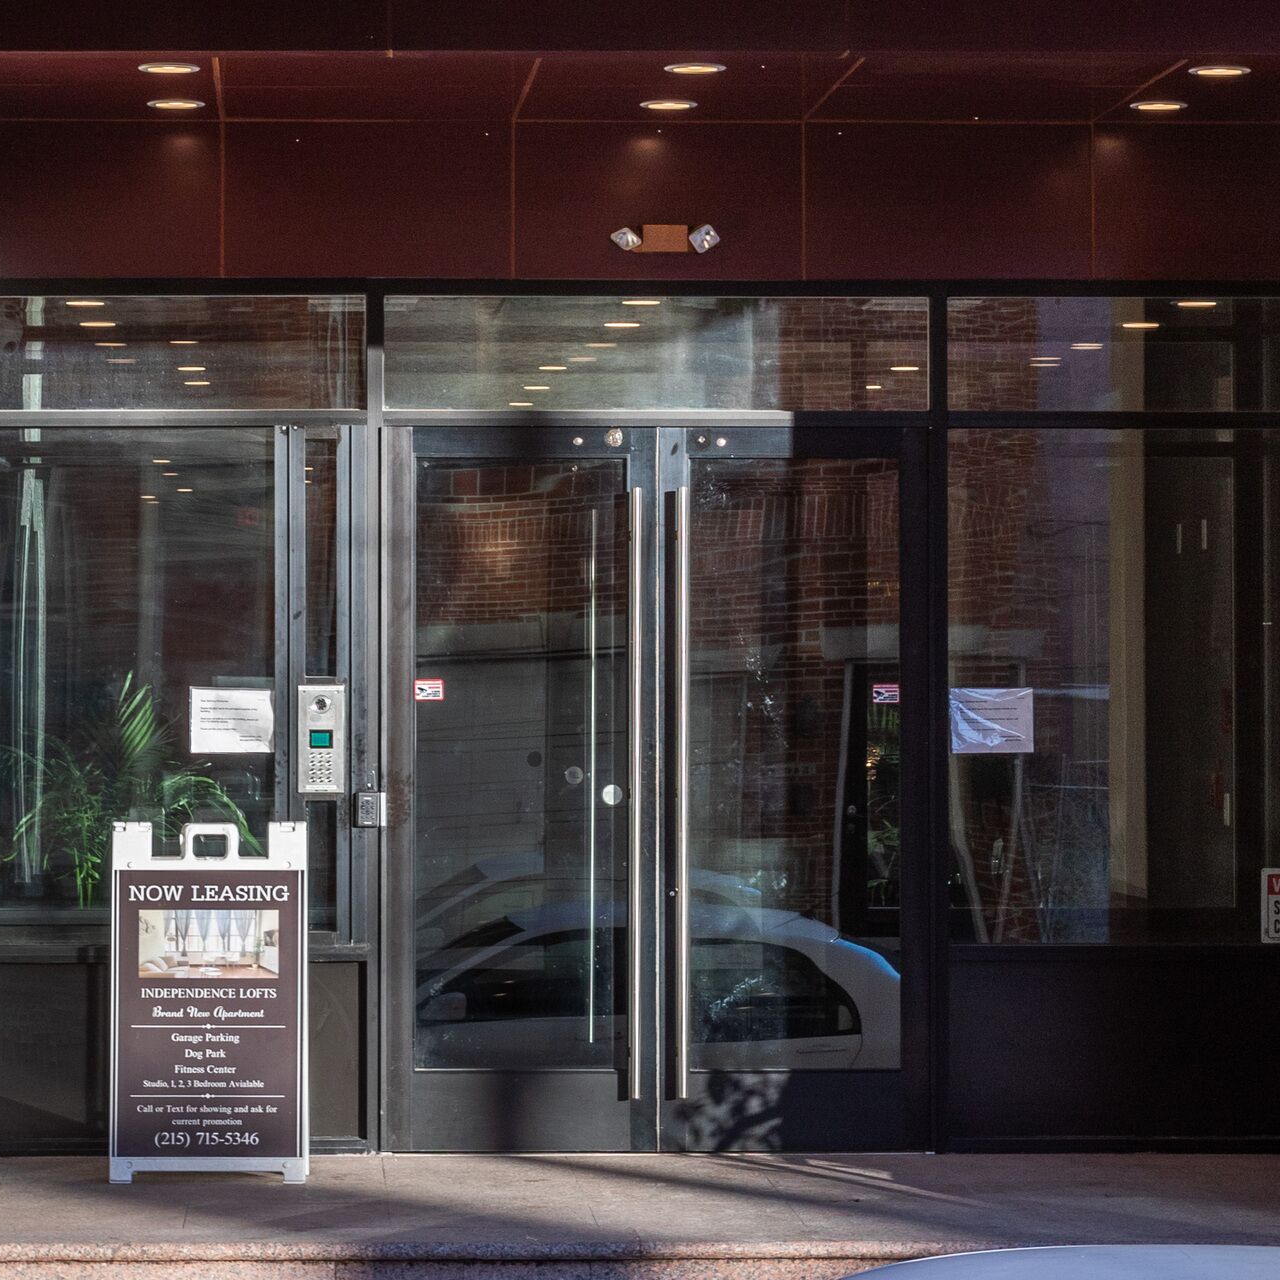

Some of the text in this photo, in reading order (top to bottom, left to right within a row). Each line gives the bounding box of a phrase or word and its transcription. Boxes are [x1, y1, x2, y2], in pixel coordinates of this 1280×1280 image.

[128, 885, 290, 902] NOW LEASING
[141, 988, 277, 999] INDEPENDENCE LOFTS
[152, 1005, 264, 1021] Brand New Apartment
[171, 1033, 240, 1044] Garage Parking
[184, 1048, 226, 1060] Dog Park
[174, 1064, 237, 1074] Fitness Center
[142, 1080, 170, 1089] Studio,
[187, 1080, 192, 1088] 3
[193, 1080, 227, 1088] Bedroom
[136, 1104, 153, 1113] Call
[166, 1104, 184, 1113] Text
[186, 1104, 197, 1113] for
[199, 1104, 232, 1114] showing
[233, 1104, 248, 1113] and
[250, 1104, 264, 1113] ask
[265, 1104, 278, 1113] for
[202, 1117, 243, 1127] promotion
[154, 1131, 260, 1148] (215) 715-5346
